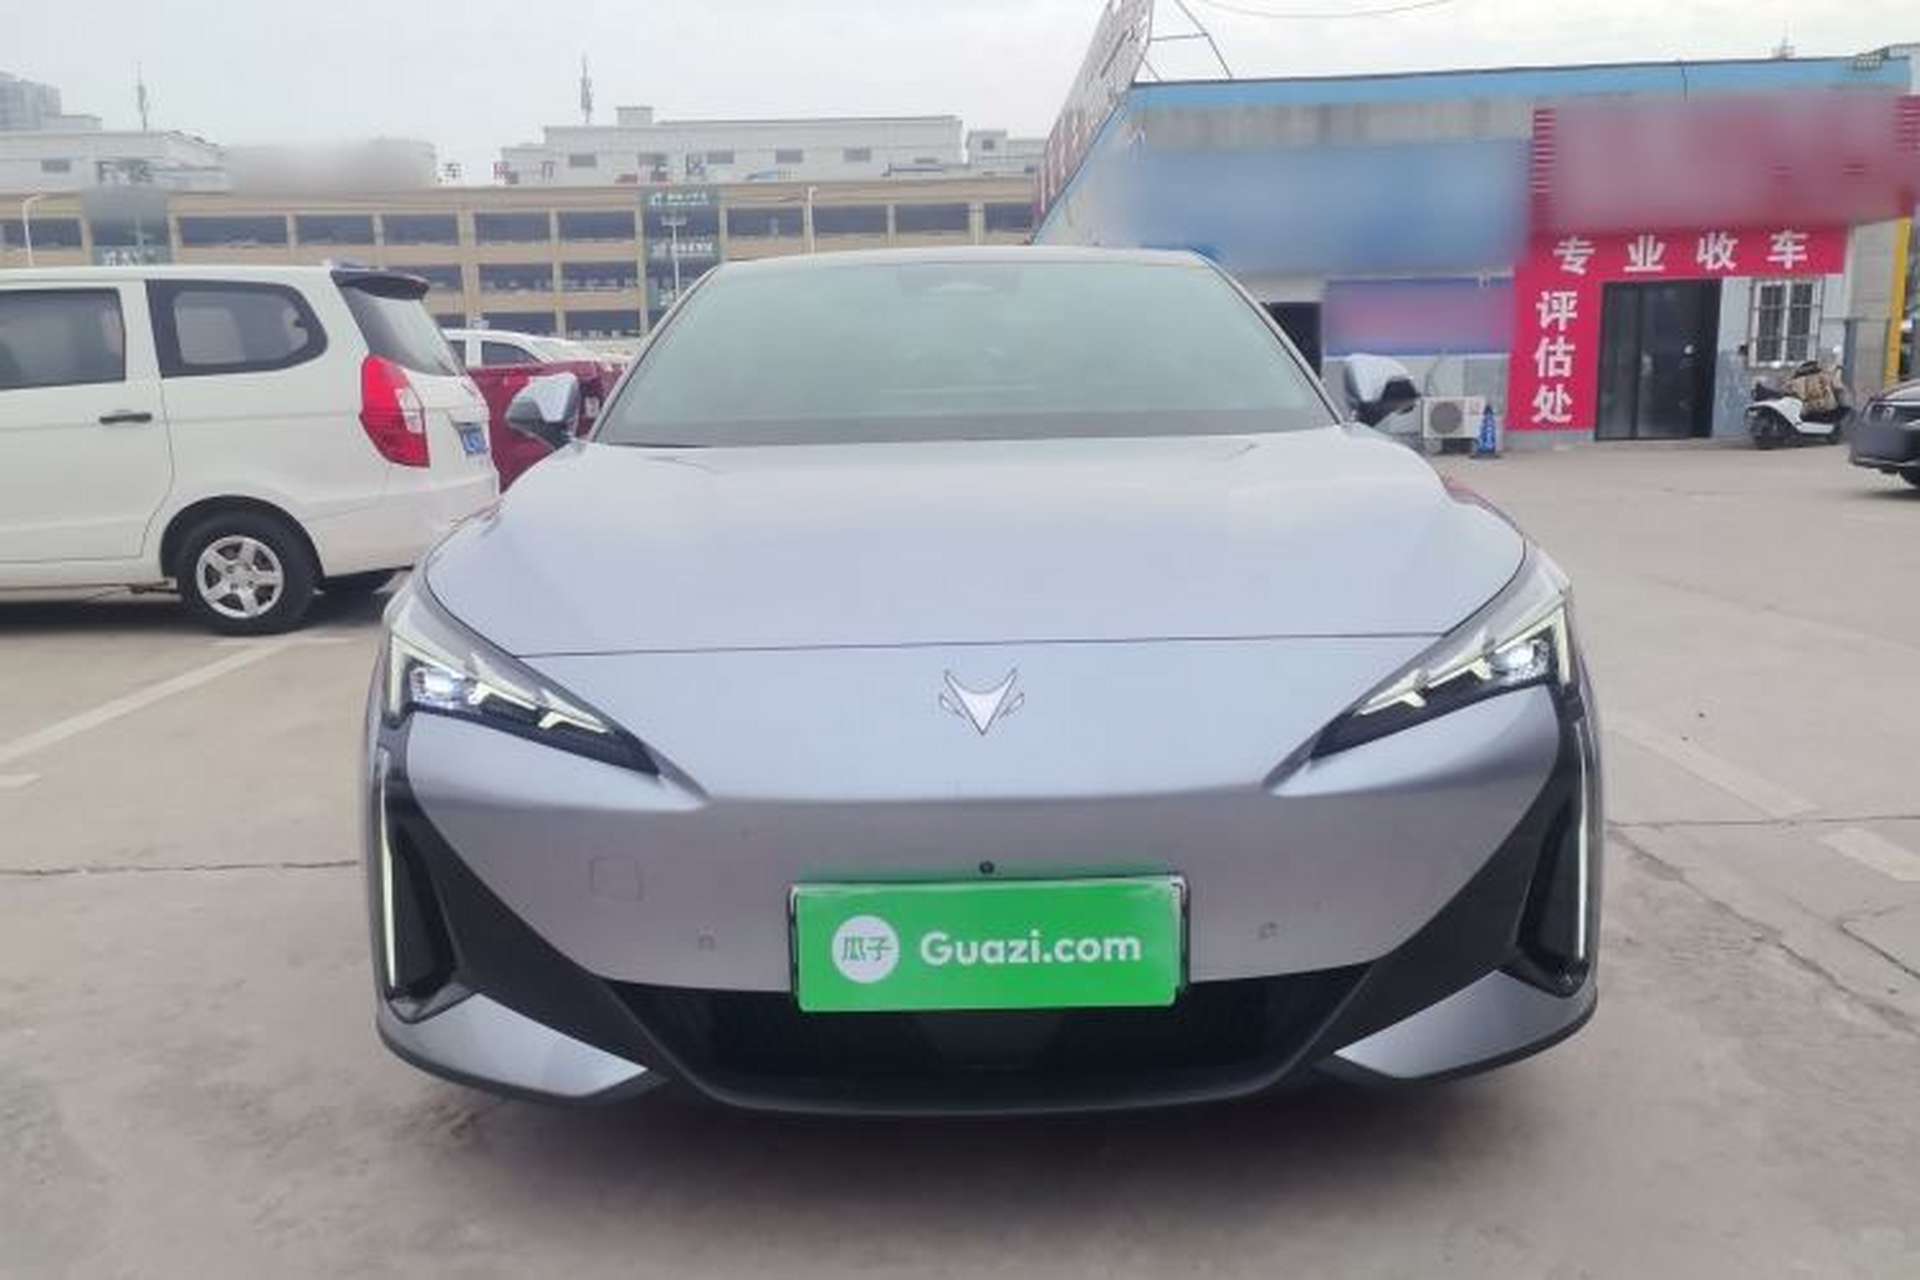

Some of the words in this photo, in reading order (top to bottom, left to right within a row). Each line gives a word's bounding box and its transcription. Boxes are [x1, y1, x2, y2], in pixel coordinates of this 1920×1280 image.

[1553, 230, 1808, 275] 专业收车
[1531, 290, 1578, 424] 评估处
